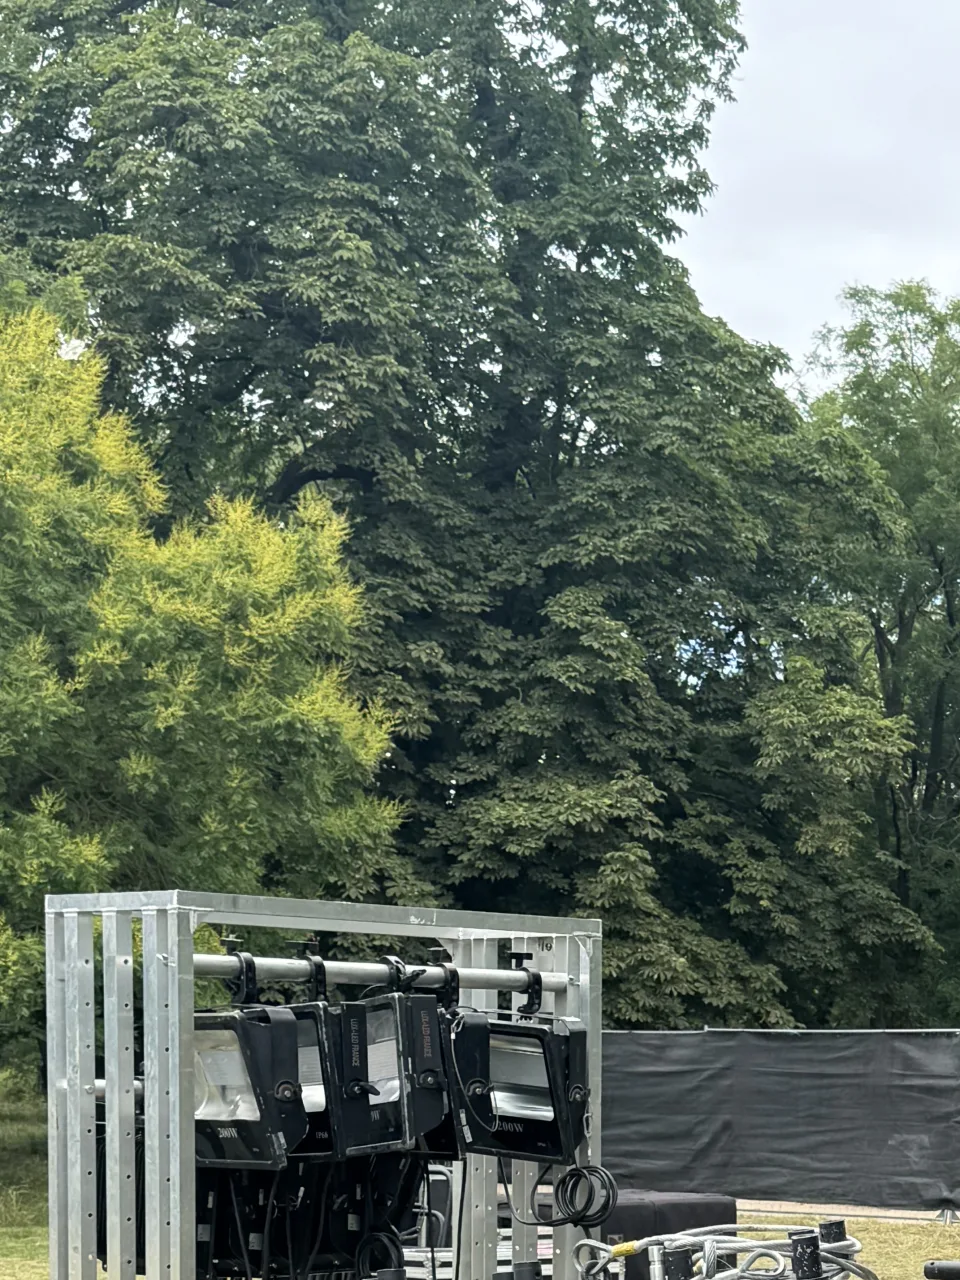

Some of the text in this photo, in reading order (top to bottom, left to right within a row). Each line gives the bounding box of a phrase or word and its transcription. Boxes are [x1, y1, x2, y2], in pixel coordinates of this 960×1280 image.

[350, 1018, 360, 1068] LUX-LED FRANCE
[422, 1036, 432, 1059] FRANCE
[217, 1127, 238, 1139] 200W
[497, 1121, 524, 1133] 200W
